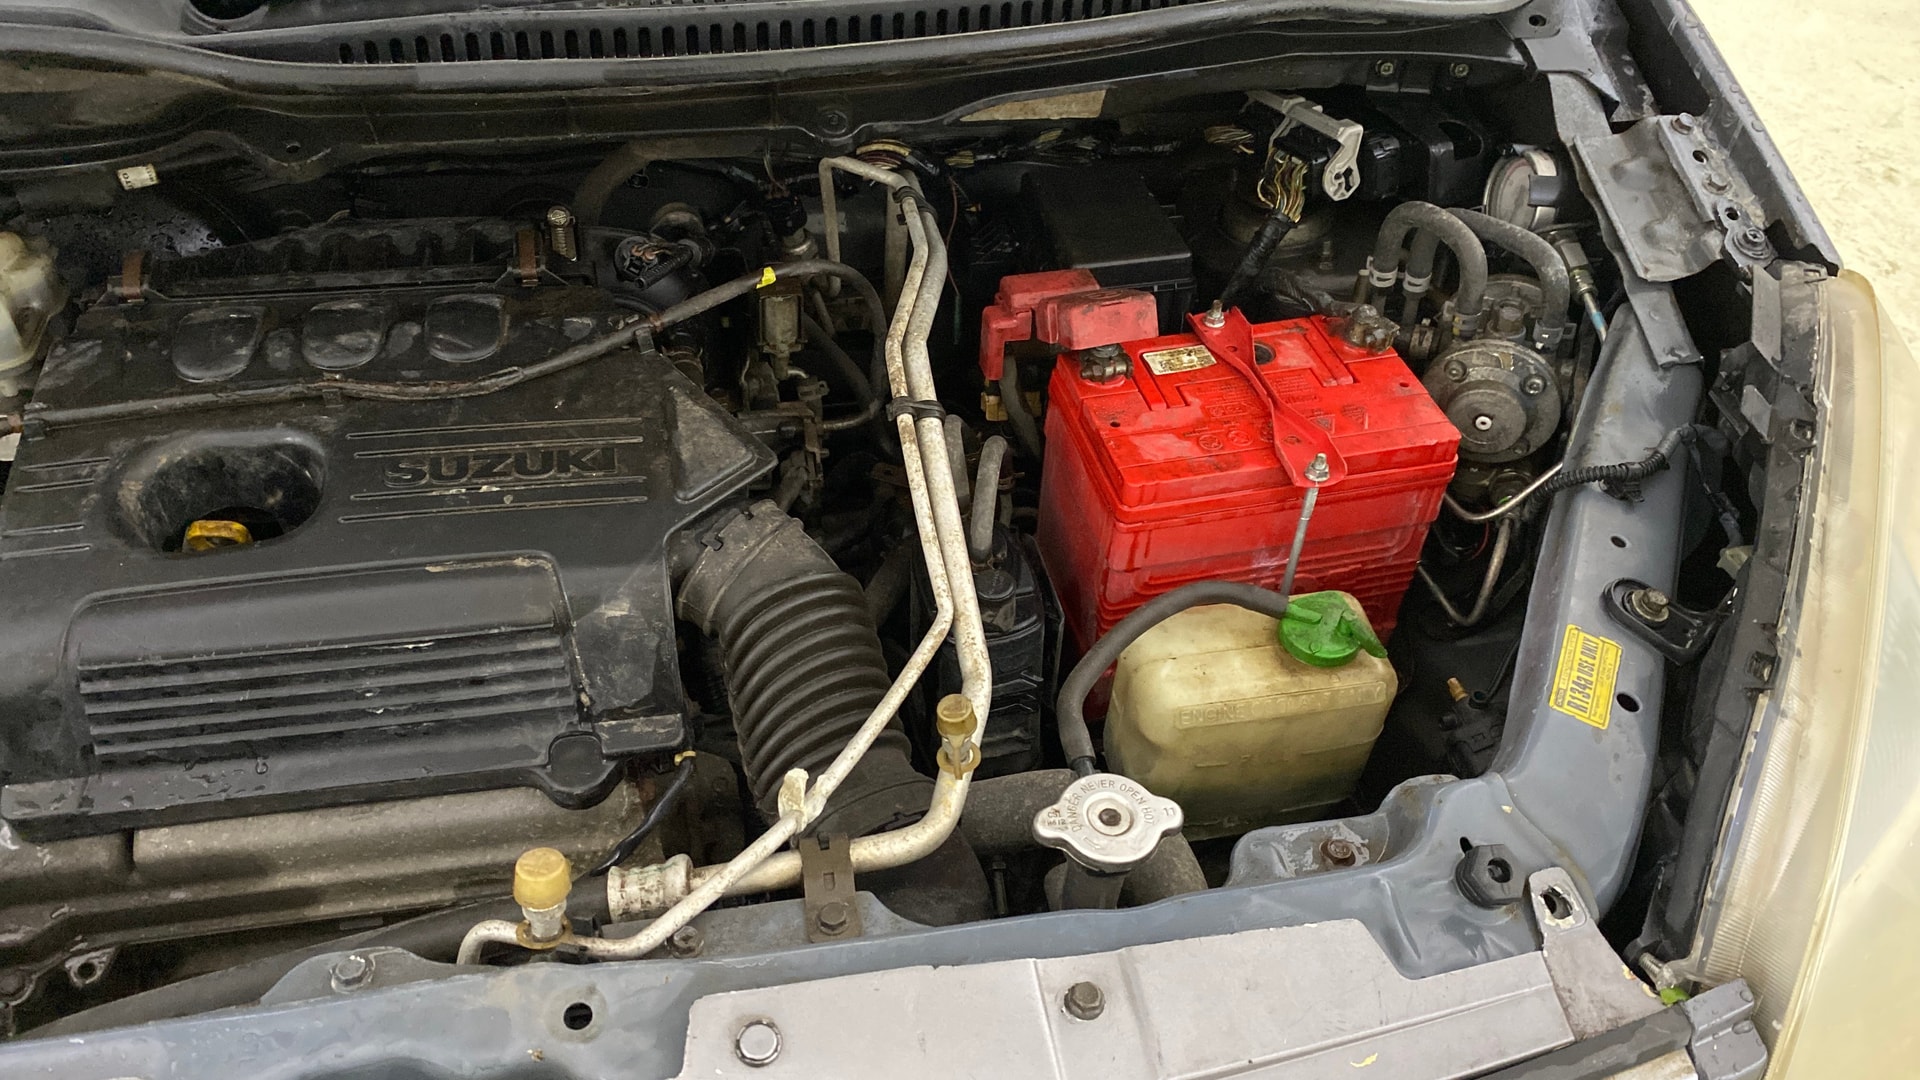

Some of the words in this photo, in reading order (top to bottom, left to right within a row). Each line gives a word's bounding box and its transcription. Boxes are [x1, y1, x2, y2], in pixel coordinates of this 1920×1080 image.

[384, 446, 618, 488] SUZUKI
[1580, 636, 1599, 660] ONLY
[1577, 657, 1595, 677] USE
[1567, 675, 1593, 713] R134a
[1179, 702, 1246, 726] ENGINE
[1067, 792, 1083, 833] DANGER
[1080, 779, 1116, 795] NEVER
[1119, 783, 1146, 806] OPEN
